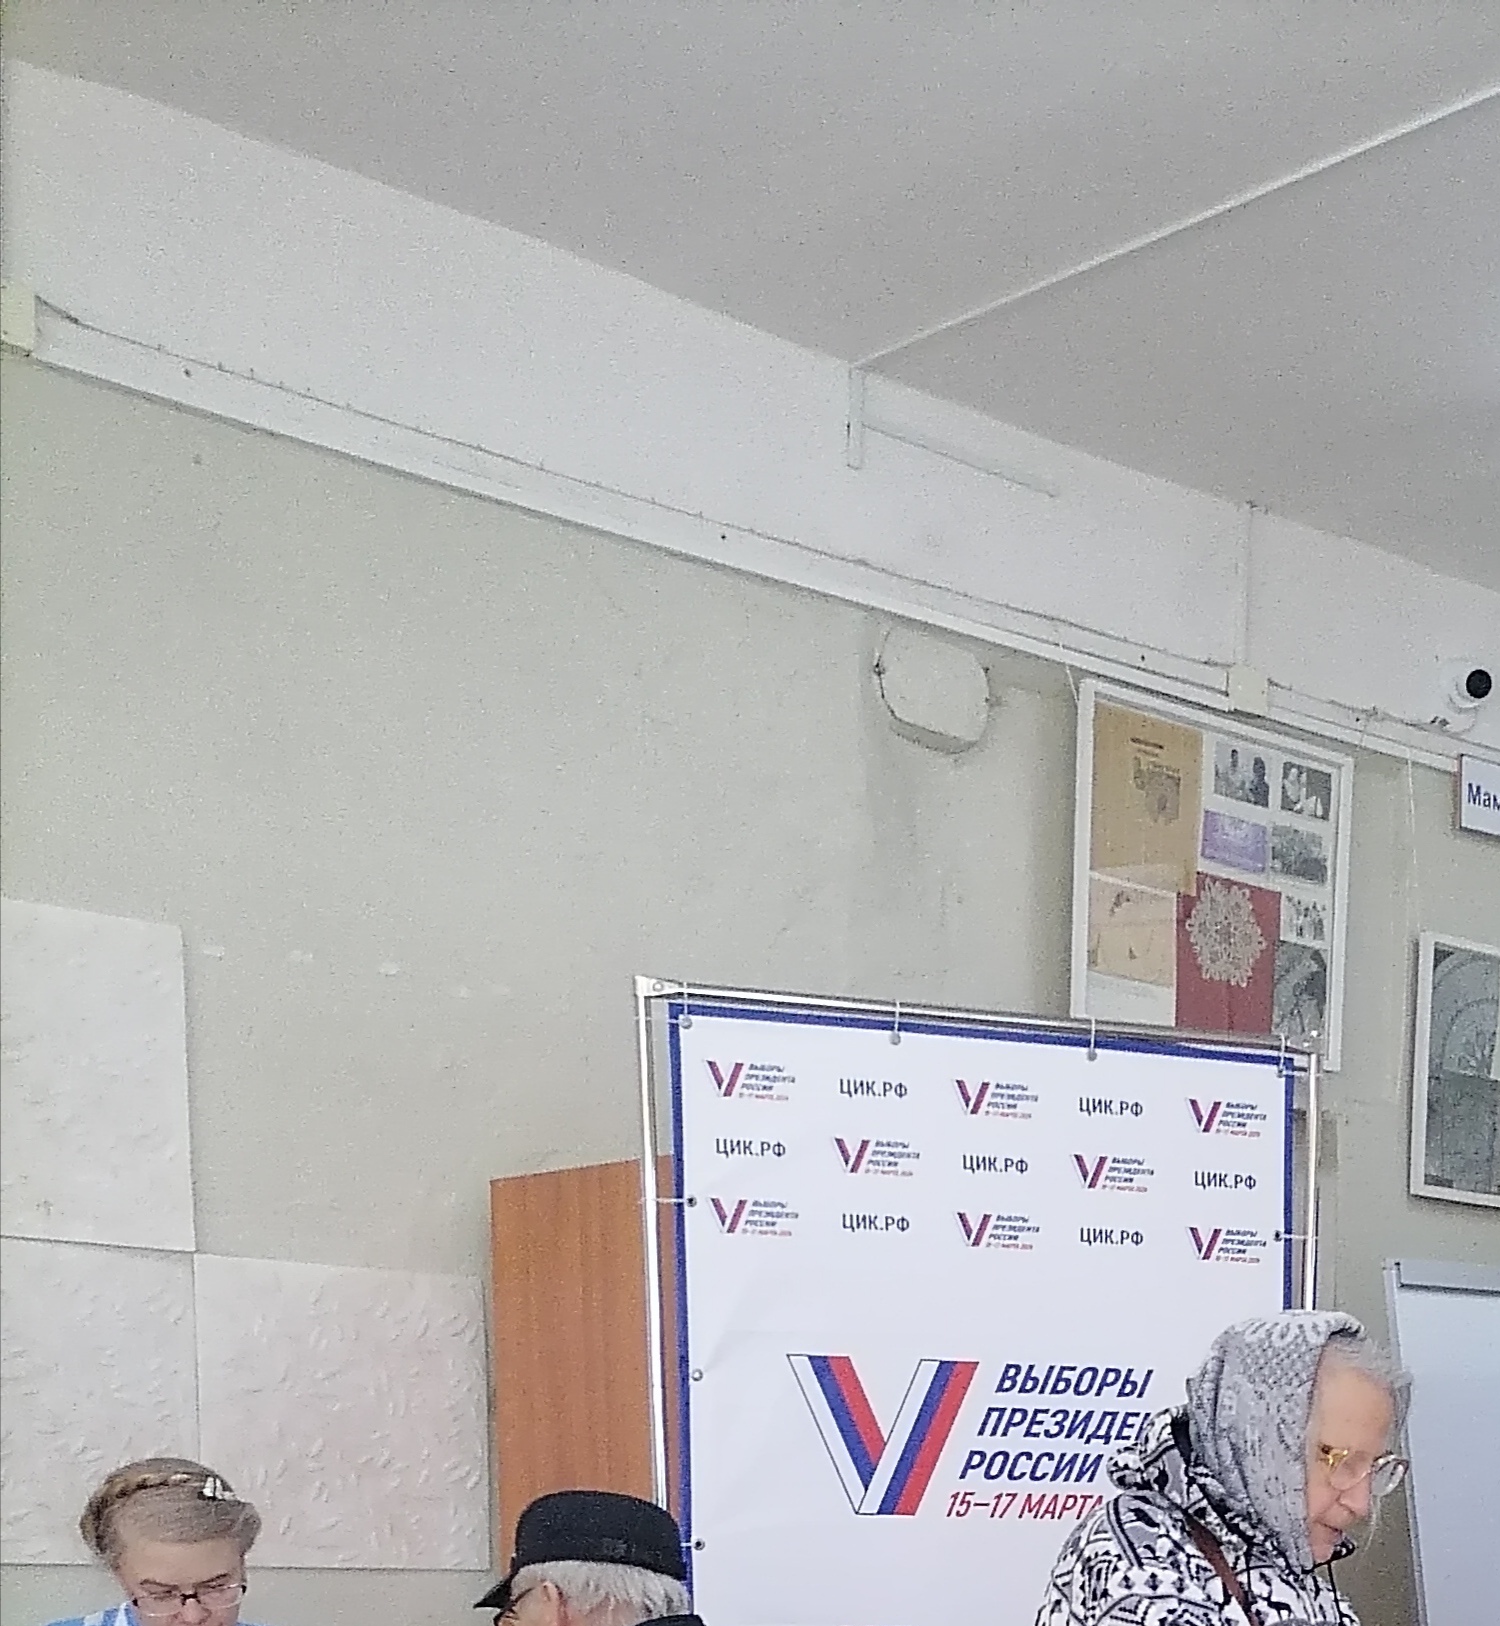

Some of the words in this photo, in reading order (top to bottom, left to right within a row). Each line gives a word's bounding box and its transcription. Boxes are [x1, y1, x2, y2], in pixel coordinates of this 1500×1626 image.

[838, 1077, 908, 1099] ЦИК.РФ
[1078, 1096, 1144, 1118] ЦИК.РФ
[715, 1137, 787, 1158] ЦИК.РФ
[962, 1153, 1029, 1175] ЦИК.РФ
[1194, 1170, 1257, 1190] ЦИК.РФ
[841, 1212, 911, 1233] ЦИК.РФ
[1079, 1226, 1144, 1247] ЦИК.РФ
[994, 1362, 1154, 1399] ВЫБОРЫ
[976, 1406, 1151, 1446] ПРЕЗИДЕ
[958, 1449, 1105, 1484] РОССИИ
